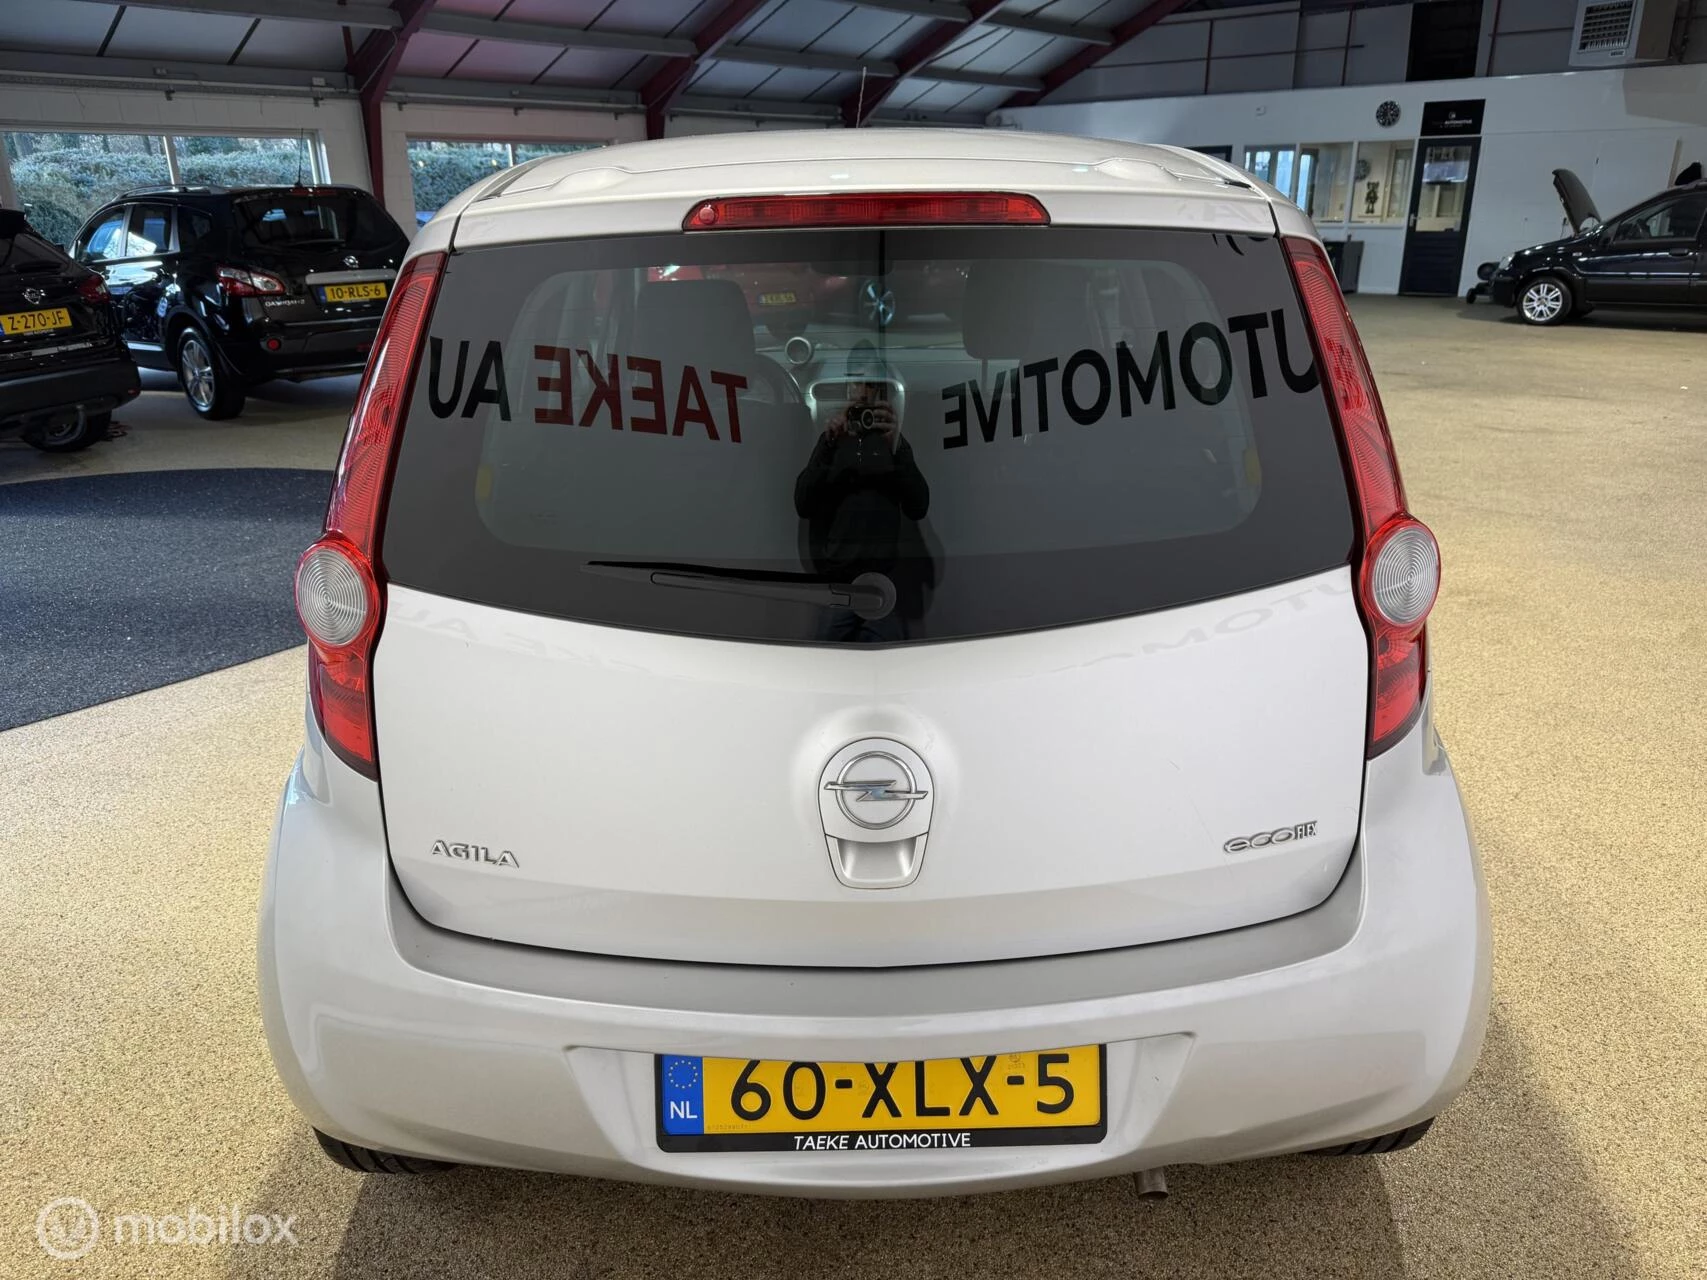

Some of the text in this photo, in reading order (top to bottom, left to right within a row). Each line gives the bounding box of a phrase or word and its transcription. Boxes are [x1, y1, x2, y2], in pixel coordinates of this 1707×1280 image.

[330, 287, 381, 300] 10-RLS-6
[8, 310, 65, 331] Z-270-JF
[431, 839, 520, 869] AGILA
[730, 1053, 1075, 1121] 60-XLX-5
[669, 1100, 698, 1119] NL
[793, 1132, 972, 1151] TAEKE AUTOMOTIVE
